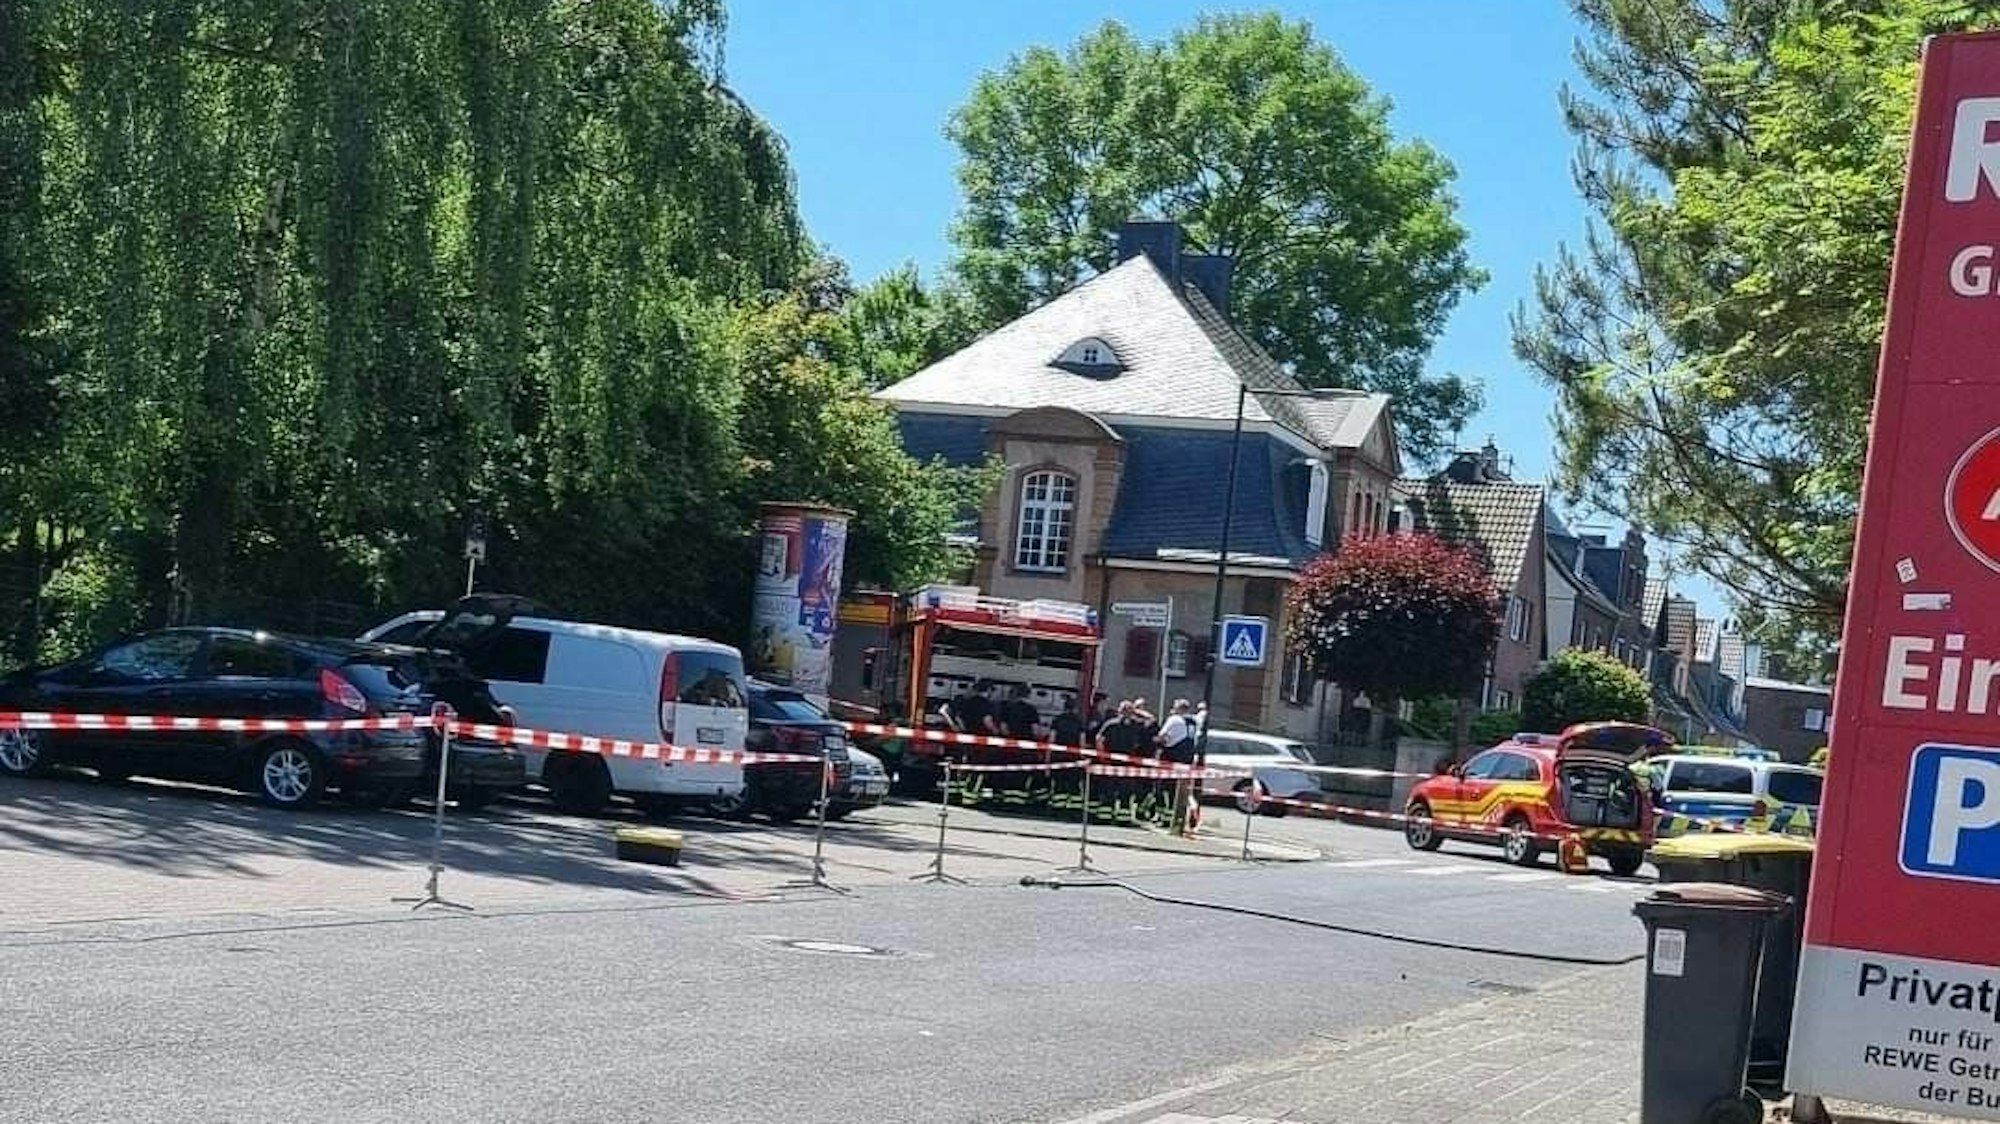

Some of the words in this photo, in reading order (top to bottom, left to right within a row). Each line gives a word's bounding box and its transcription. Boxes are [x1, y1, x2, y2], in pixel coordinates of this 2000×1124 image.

[1950, 245, 2000, 297] G
[1928, 756, 2000, 867] P
[1908, 1027, 1950, 1046] nur
[1958, 1029, 1993, 1052] für
[1864, 1045, 1941, 1074] REWE
[1918, 1081, 1960, 1103] der
